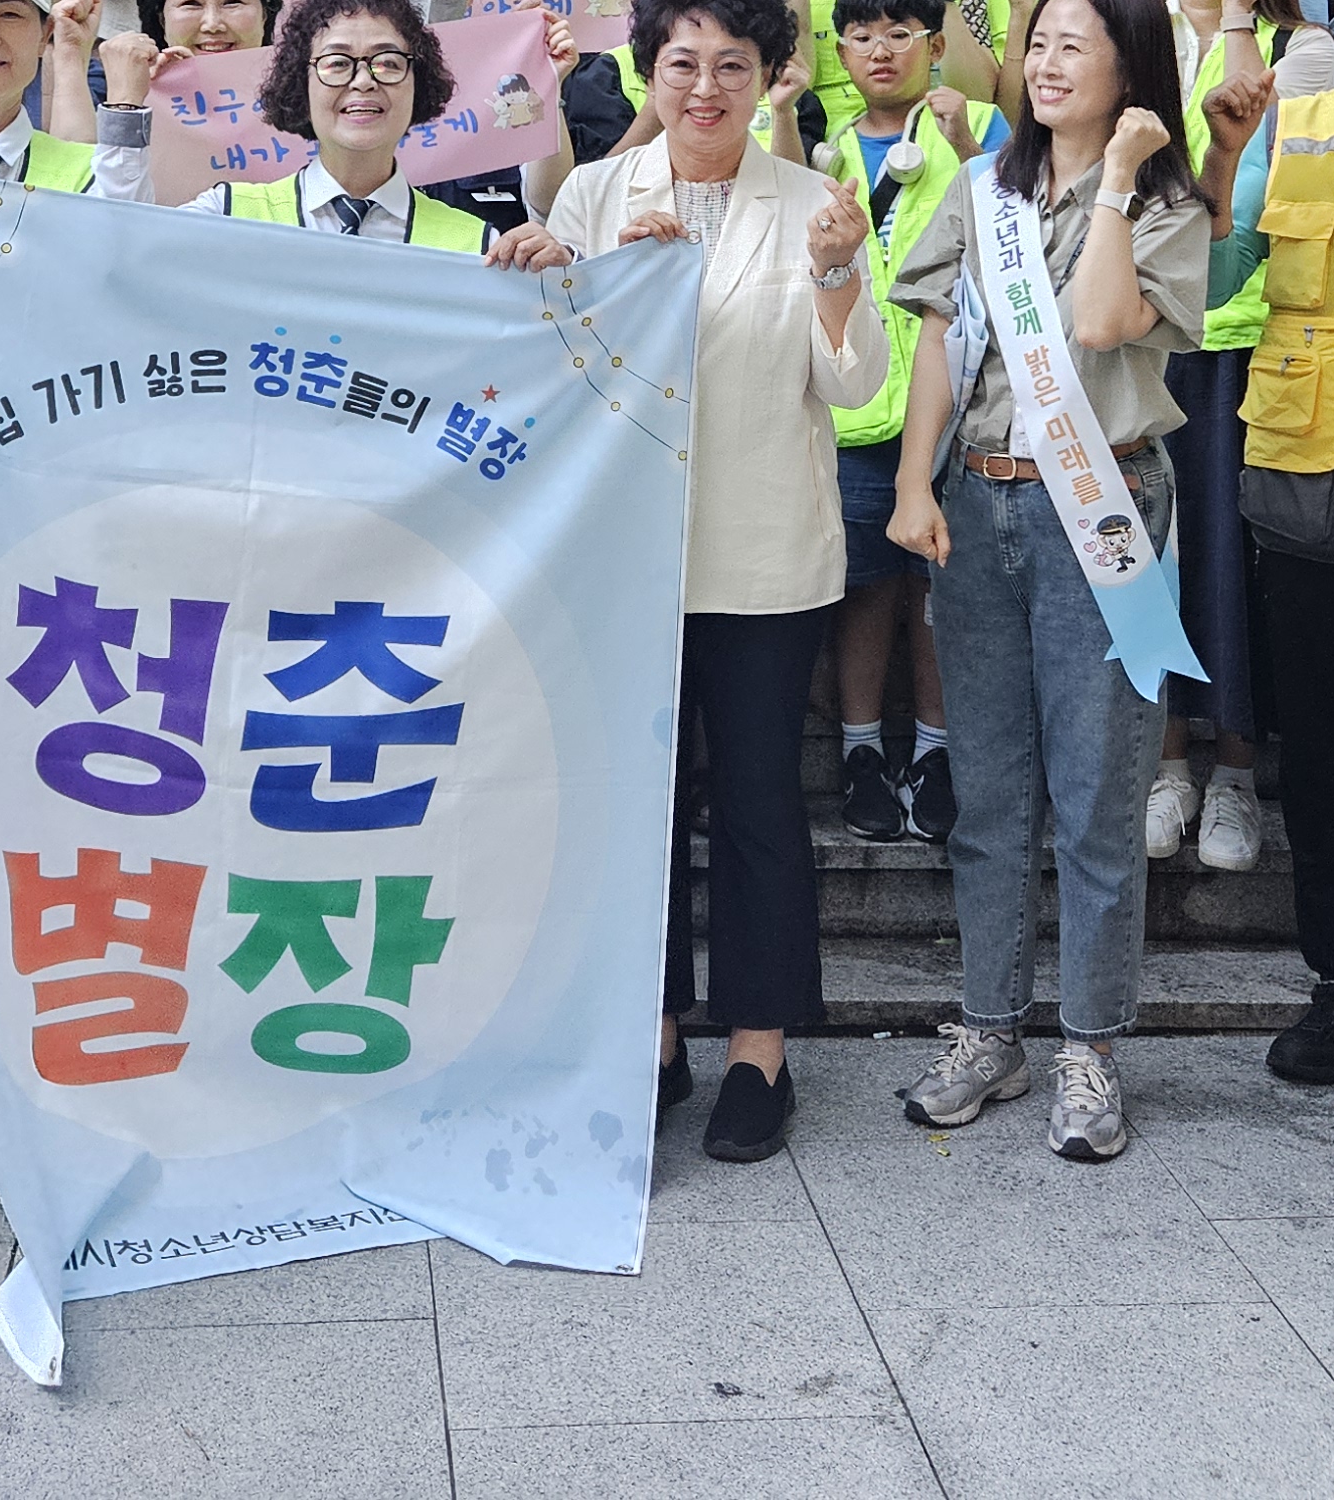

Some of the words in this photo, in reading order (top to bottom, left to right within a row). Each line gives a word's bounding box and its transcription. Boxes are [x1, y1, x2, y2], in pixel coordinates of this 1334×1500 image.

[209, 136, 290, 171] 내가
[990, 175, 1026, 273] 청소년과
[1004, 277, 1044, 336] 함께
[32, 359, 127, 424] 가기
[141, 348, 229, 398] 싫은
[247, 338, 432, 434] 청춘들의
[435, 400, 528, 481] 별장
[1022, 343, 1062, 409] 밝은
[1043, 410, 1105, 506] 미래를
[4, 575, 466, 834] 청춘
[2, 846, 457, 1088] 별장
